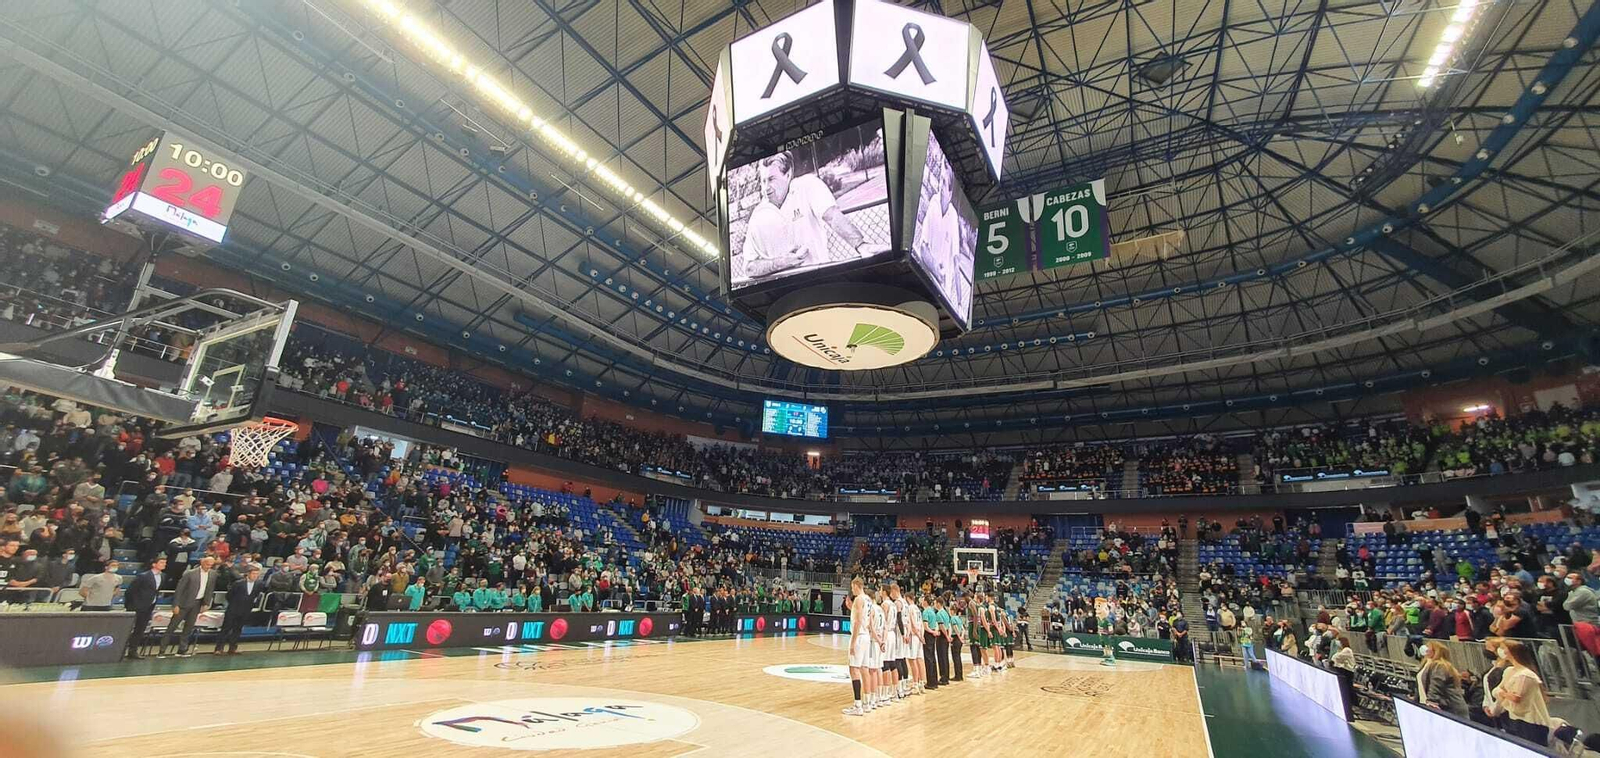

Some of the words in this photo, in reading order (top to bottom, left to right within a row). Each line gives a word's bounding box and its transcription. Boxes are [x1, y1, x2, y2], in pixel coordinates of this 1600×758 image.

[170, 142, 243, 187] 10:00
[153, 168, 222, 218] 24
[1046, 189, 1091, 206] CABEZAS
[983, 207, 1009, 221] BERNI
[1051, 204, 1089, 242] 10
[986, 221, 1009, 255] 5
[803, 333, 852, 364] Unicaja
[385, 623, 418, 644] NXT
[521, 621, 545, 639] NXT
